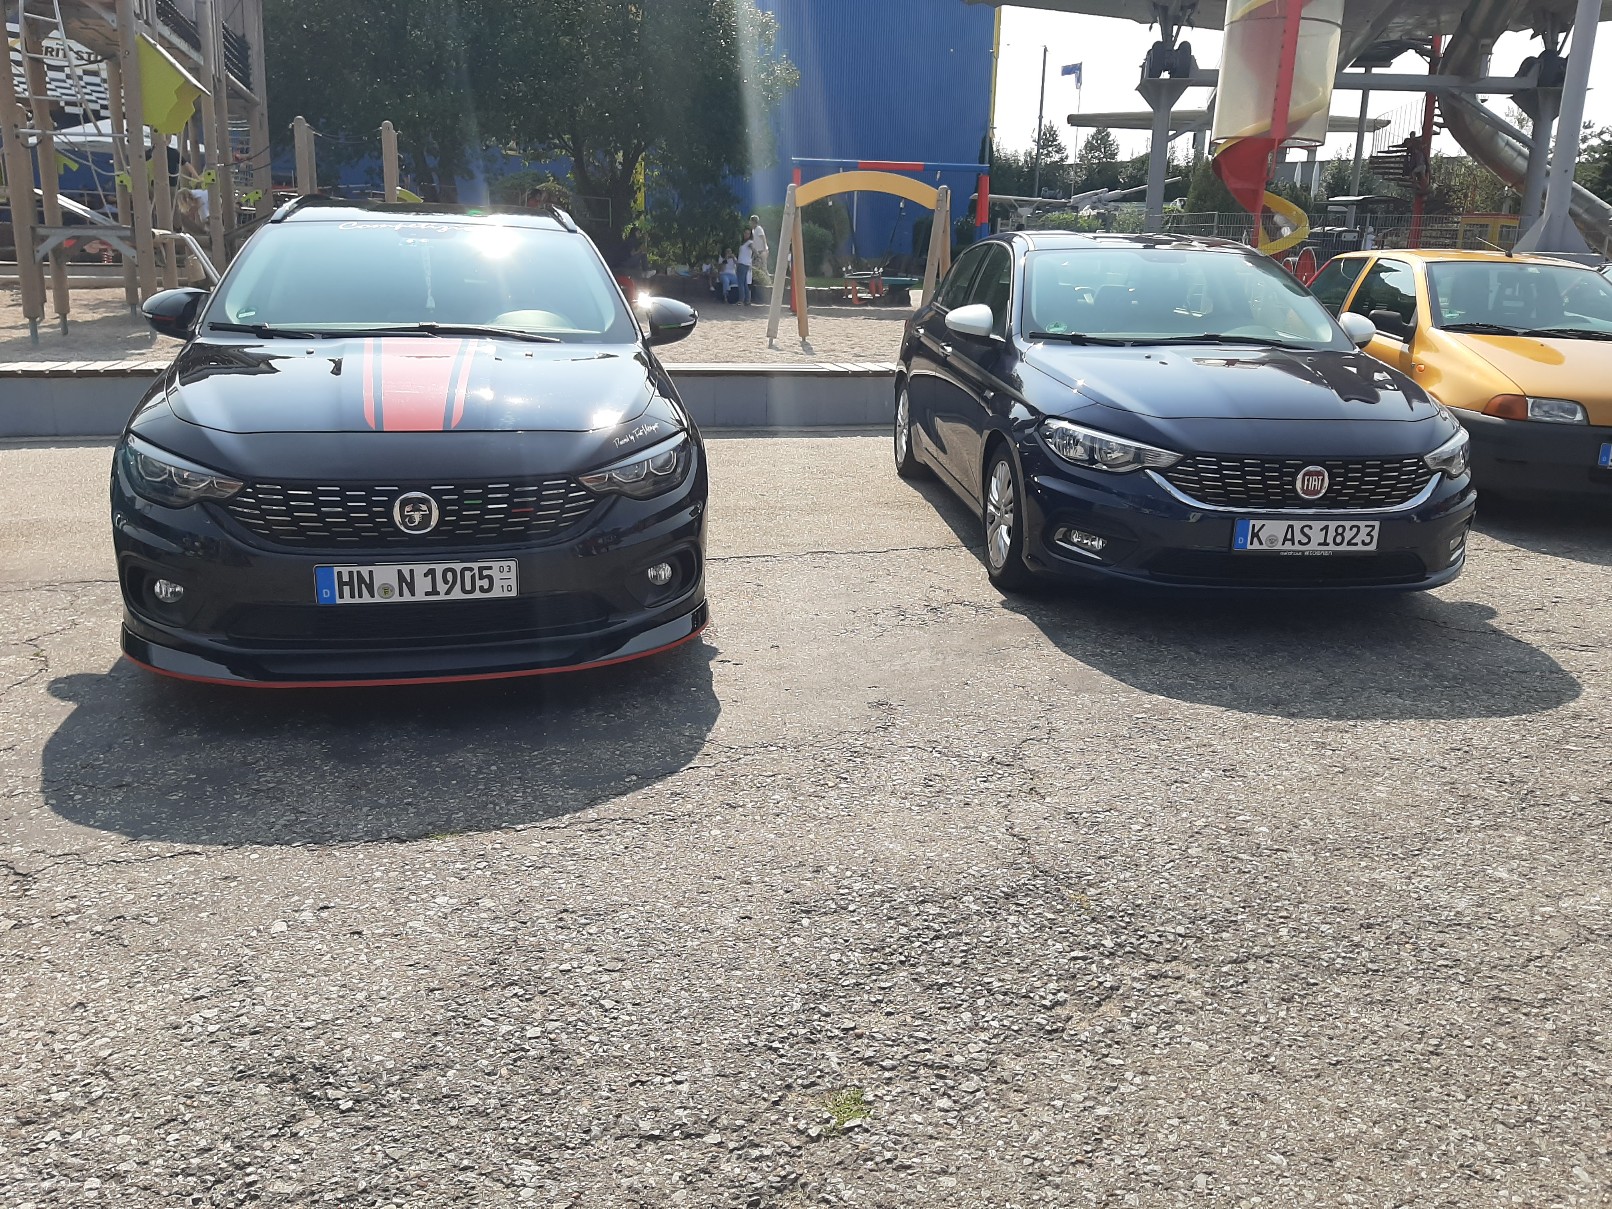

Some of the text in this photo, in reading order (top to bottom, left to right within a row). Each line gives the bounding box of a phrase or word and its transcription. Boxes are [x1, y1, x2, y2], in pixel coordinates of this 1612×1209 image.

[1304, 476, 1324, 491] FIAT
[1249, 523, 1266, 546] K
[1282, 524, 1313, 546] AS
[1317, 524, 1376, 547] 1823
[323, 565, 494, 599] D HN N 1905
